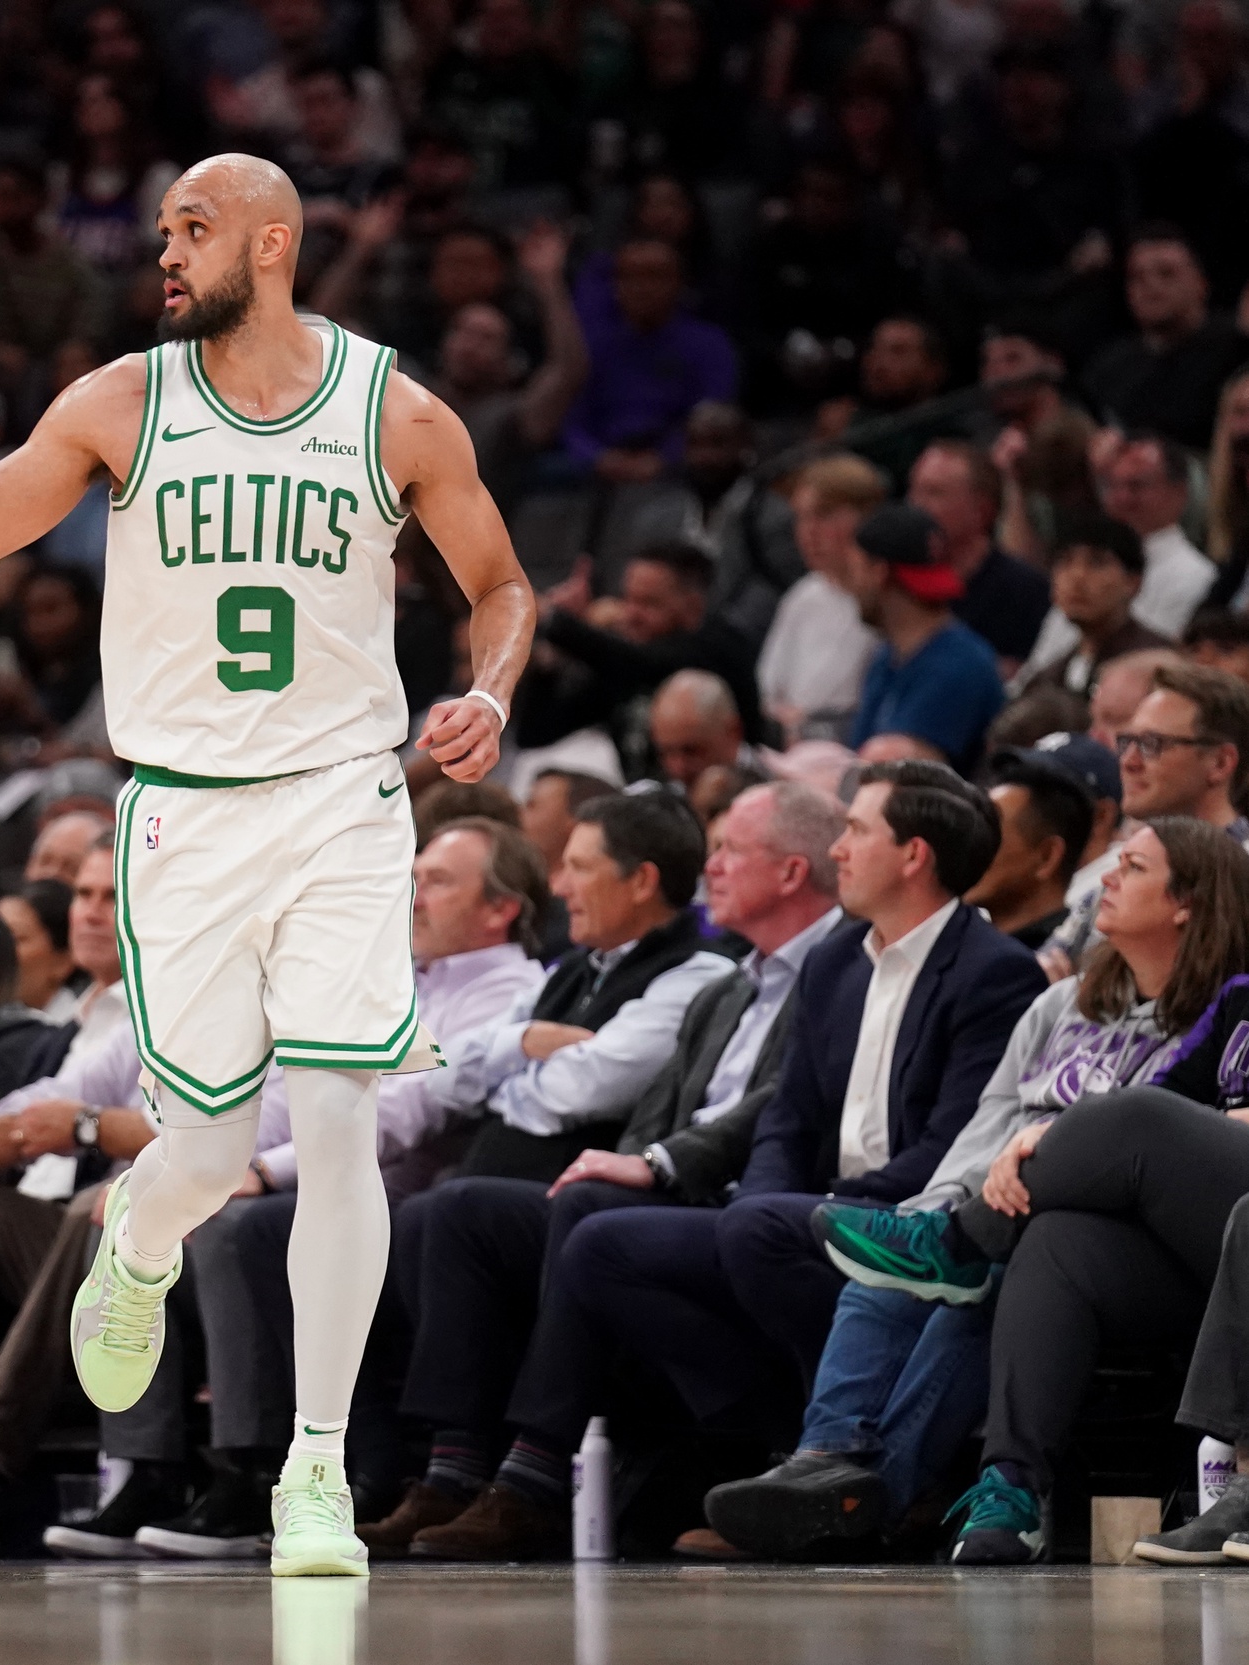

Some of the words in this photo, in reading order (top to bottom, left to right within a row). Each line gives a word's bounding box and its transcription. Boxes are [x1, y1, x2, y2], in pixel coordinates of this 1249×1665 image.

[301, 436, 357, 456] Amica
[156, 474, 359, 575] CELTICS
[217, 586, 295, 692] 9
